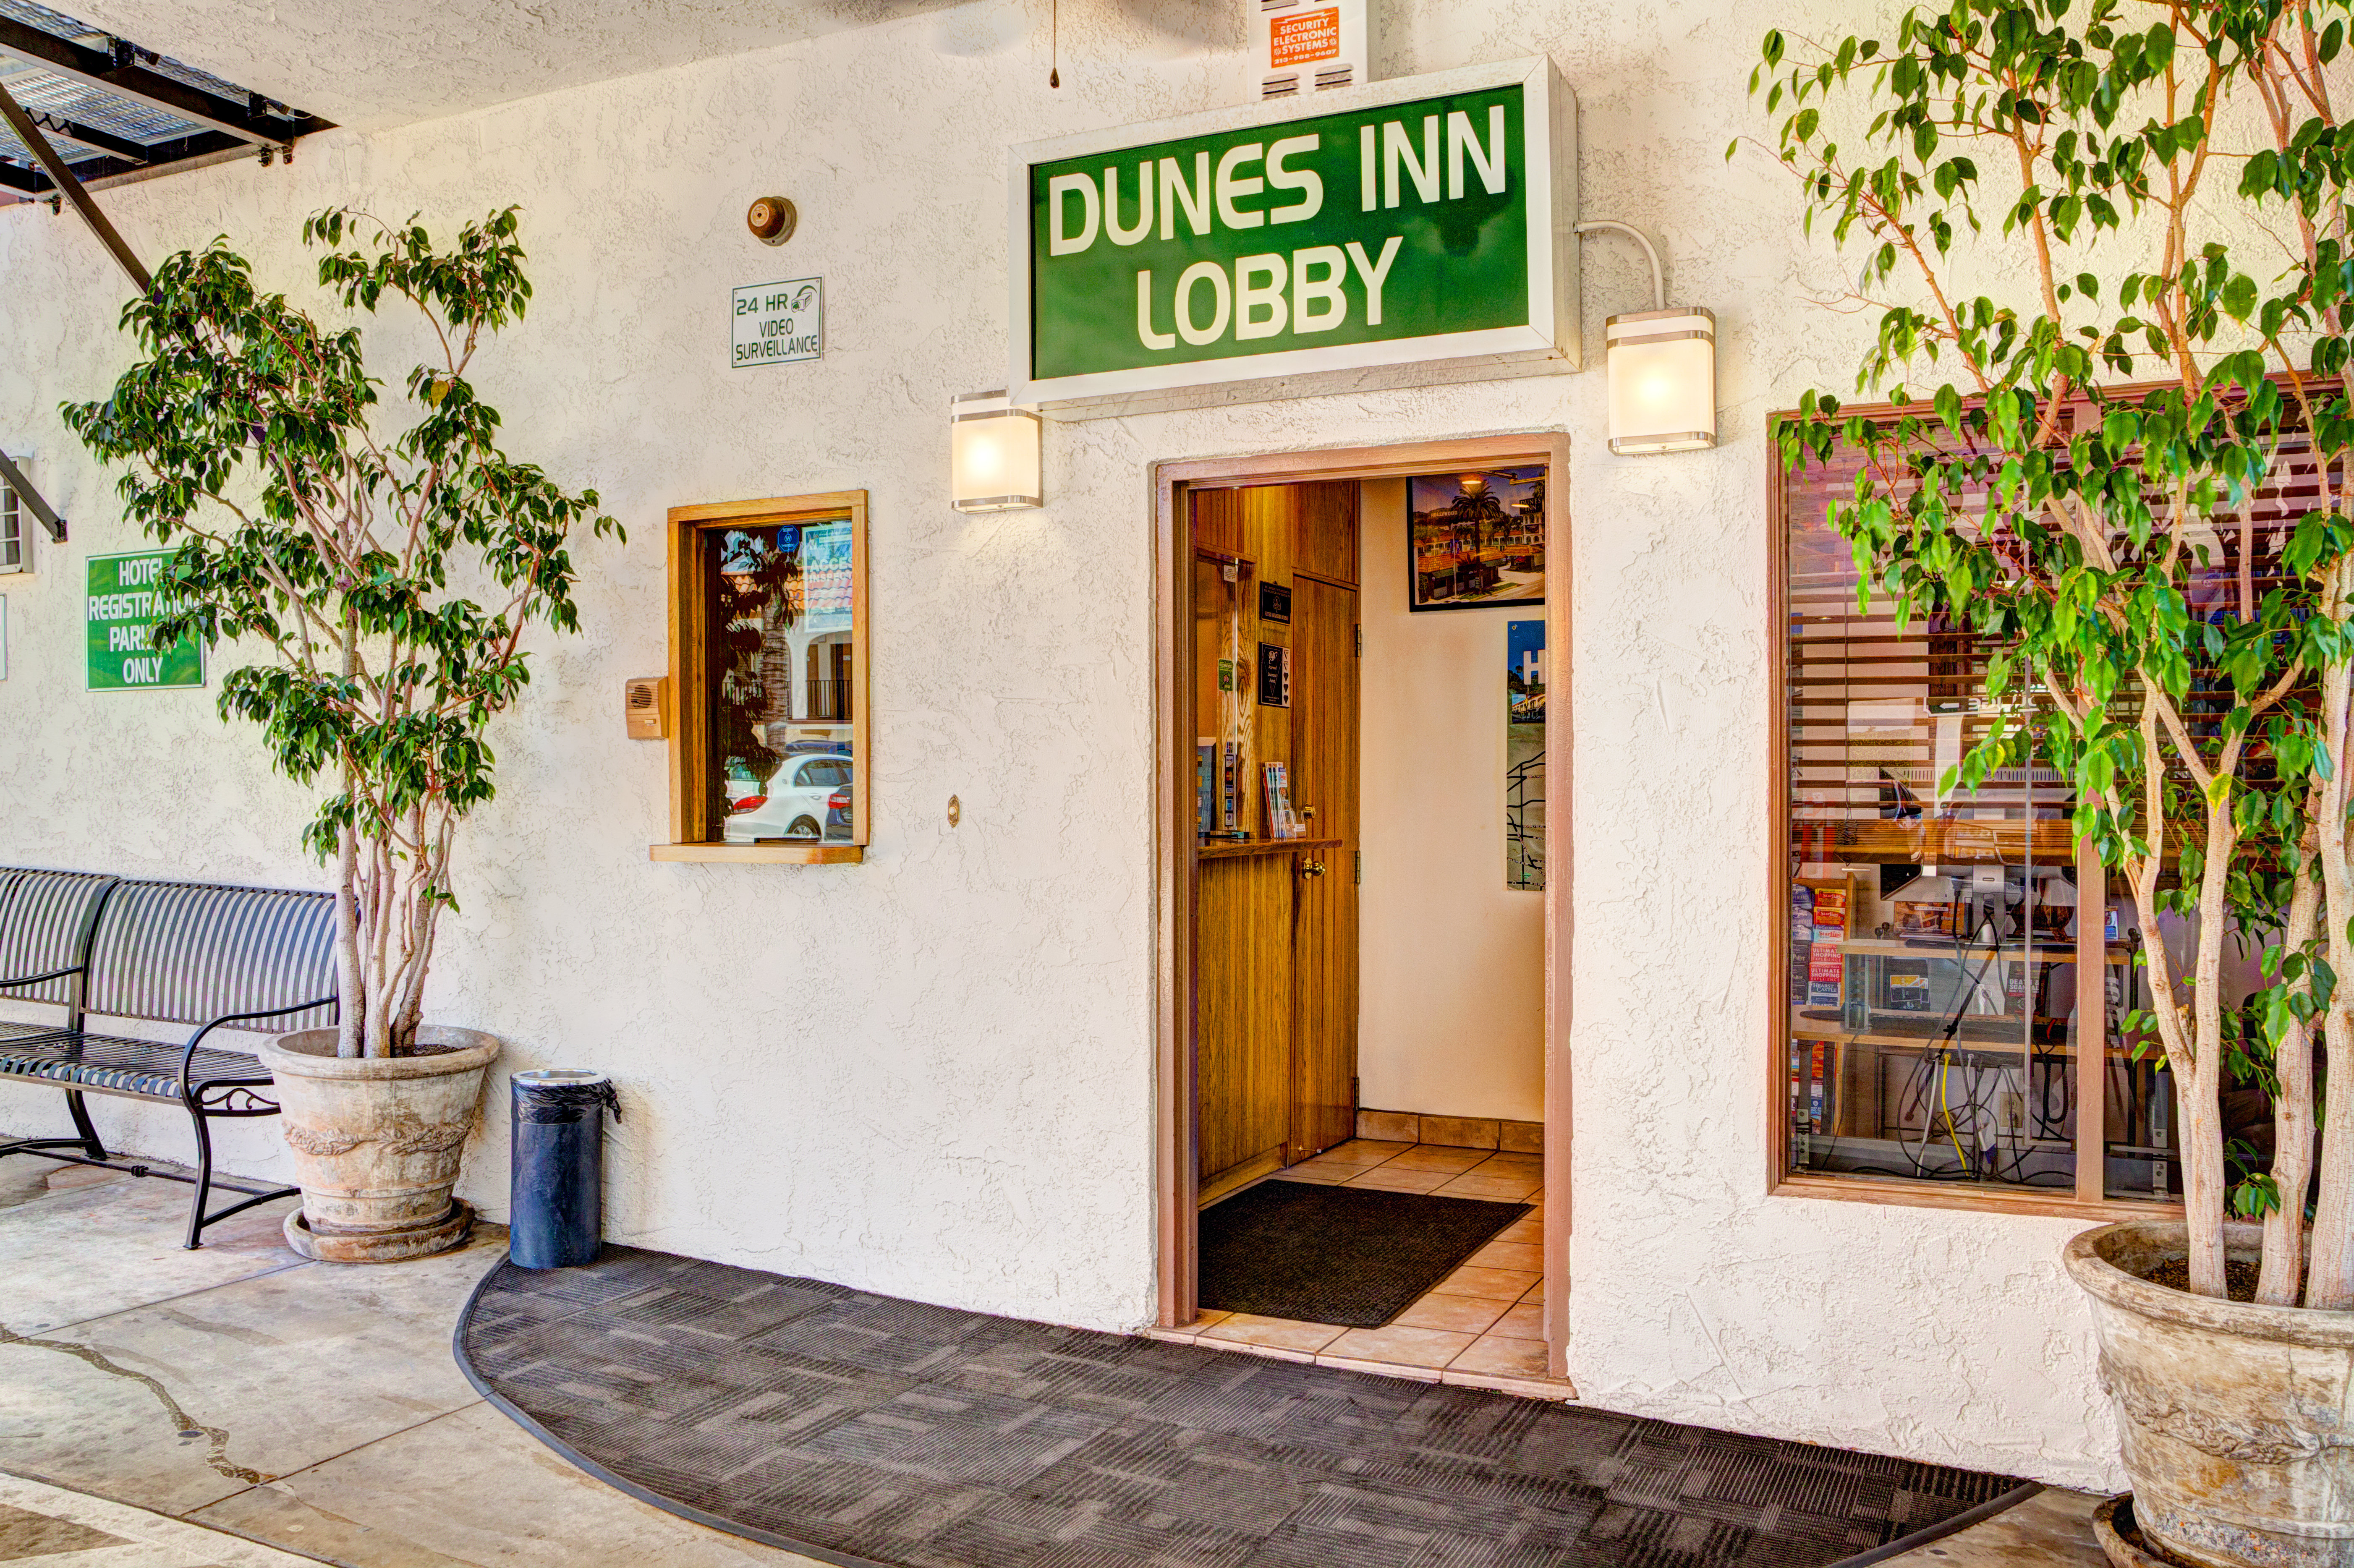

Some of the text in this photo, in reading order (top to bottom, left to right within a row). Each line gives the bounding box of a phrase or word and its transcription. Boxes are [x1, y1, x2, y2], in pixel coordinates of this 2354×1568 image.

[1274, 26, 1337, 46] ELECTRONIC
[1280, 17, 1329, 35] SECURITY
[1274, 49, 1337, 64] 213-988-9607
[1282, 38, 1328, 55] SYSTEMS
[1049, 105, 1506, 256] DUNES INN
[1137, 236, 1404, 350] LOBBY
[736, 293, 788, 316] 24 HR
[759, 318, 794, 338] VIDEO
[735, 335, 818, 361] SURVEILLANCE
[123, 656, 163, 683] ONLY
